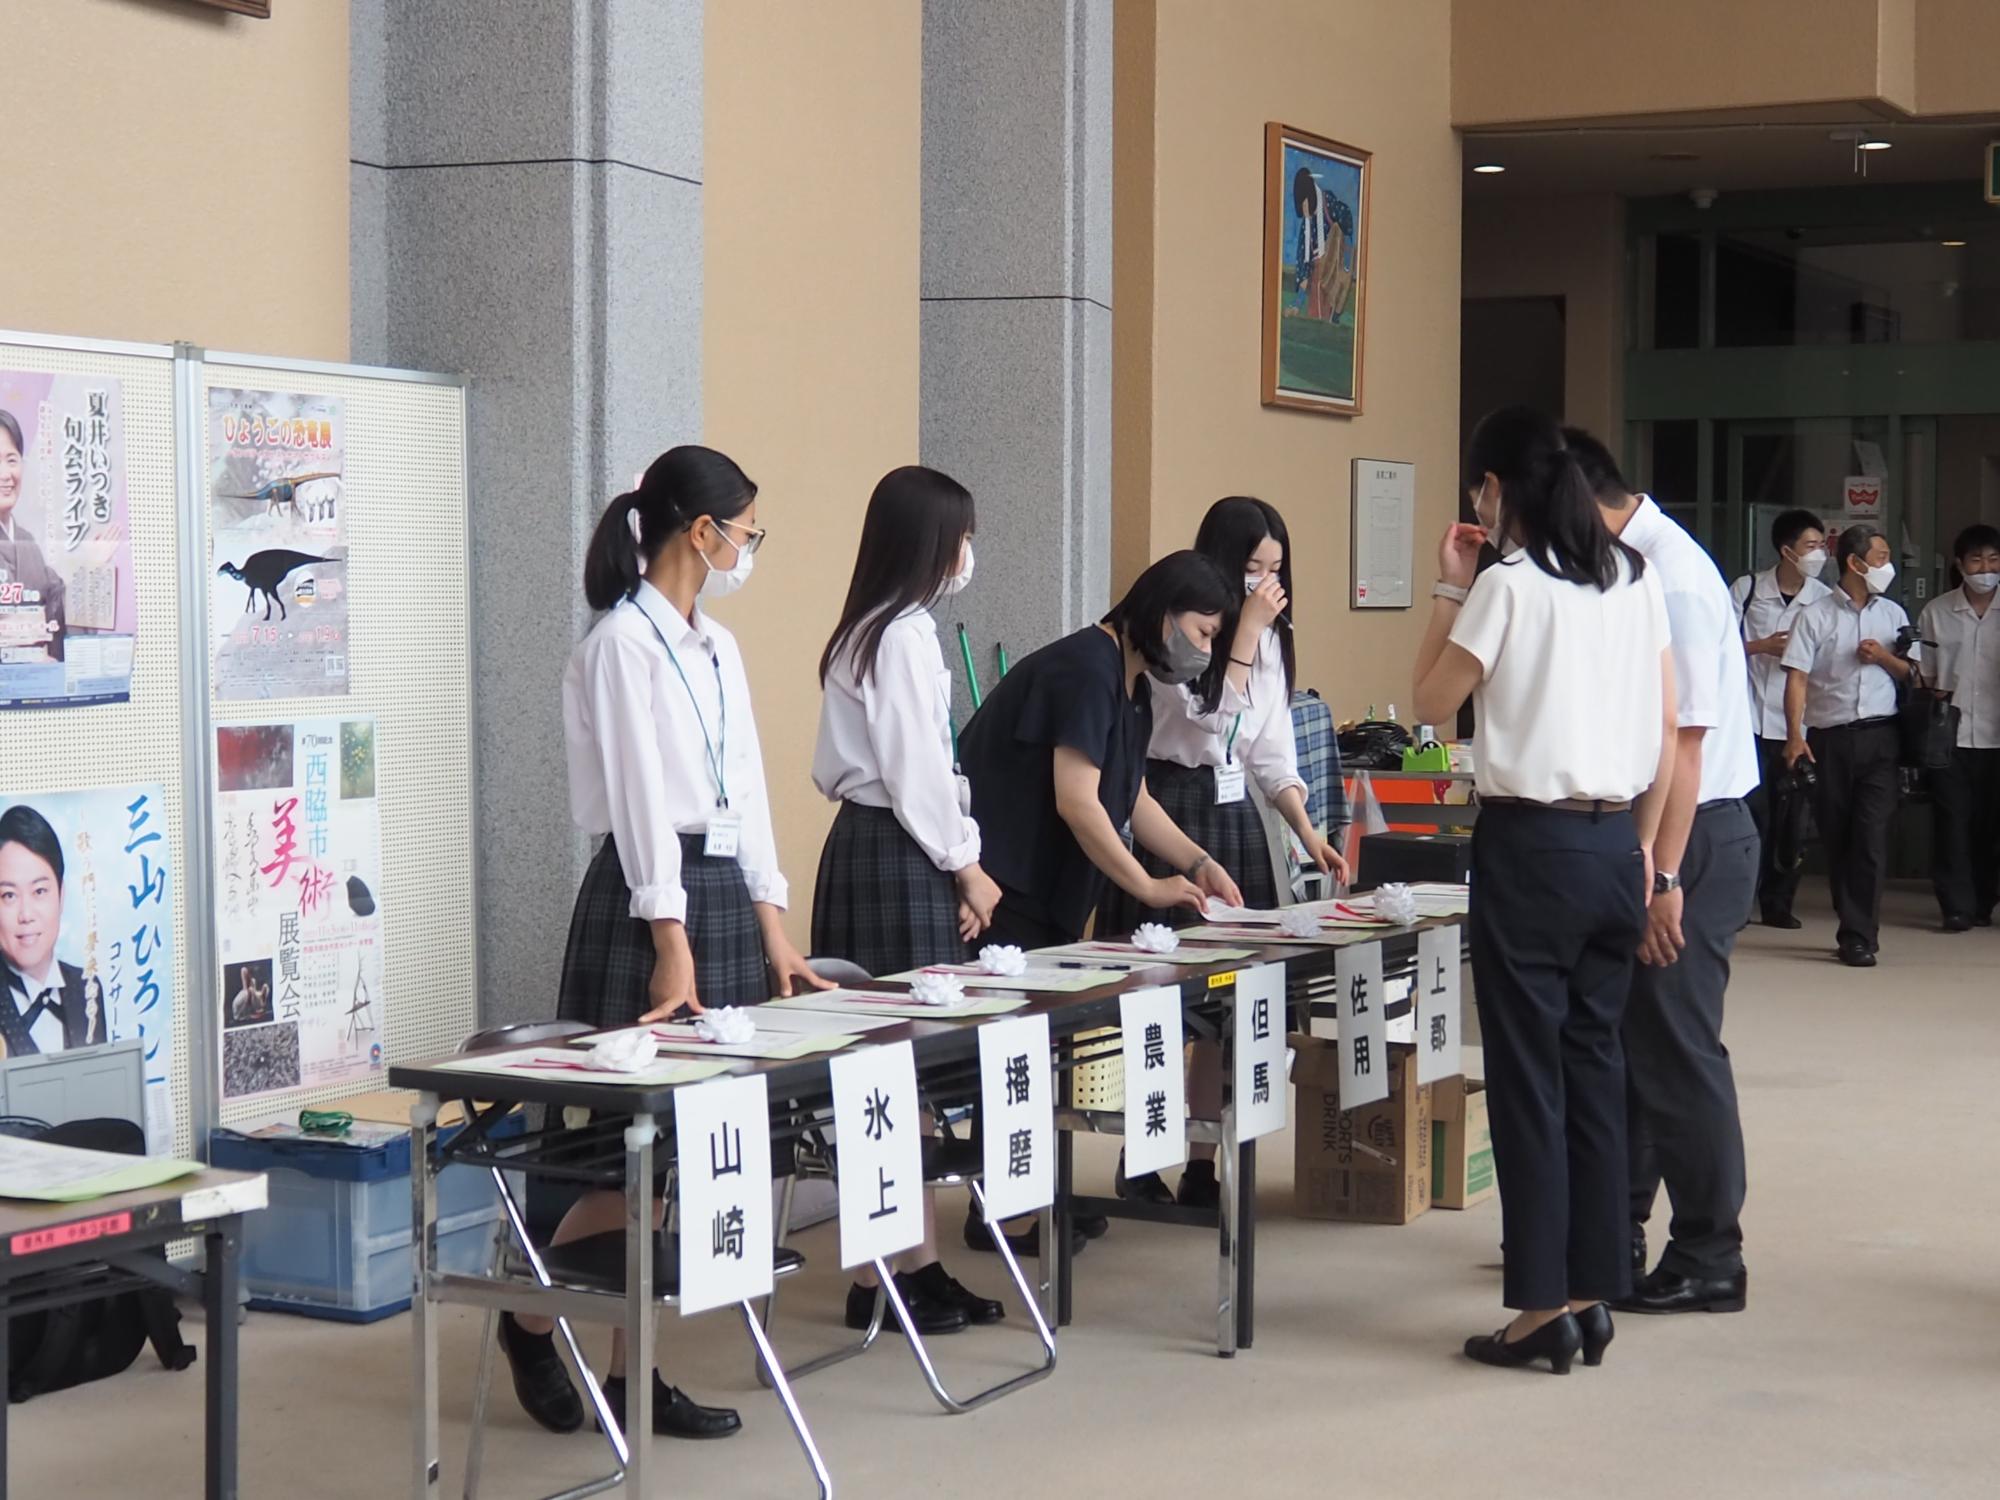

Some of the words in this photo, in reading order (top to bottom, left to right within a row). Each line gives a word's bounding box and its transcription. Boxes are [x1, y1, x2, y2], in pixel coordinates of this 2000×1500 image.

[64, 417, 88, 553] 句会ライブ
[89, 392, 109, 519] 夏井いつき
[305, 753, 329, 858] 西脇市
[125, 795, 166, 1060] 三山ひろし
[278, 911, 300, 1019] 展覧会
[108, 942, 123, 1046] コンサート
[1350, 974, 1370, 1077] 佐用
[1430, 956, 1446, 1053] 上郡
[1144, 1022, 1167, 1137] 農業
[1252, 998, 1270, 1105] 但馬
[864, 1087, 898, 1220] 氷上
[1005, 1053, 1032, 1179] 播磨
[1323, 1093, 1337, 1152] DRINK
[1338, 1110, 1353, 1164] PORTS
[710, 1121, 744, 1260] 山崎
